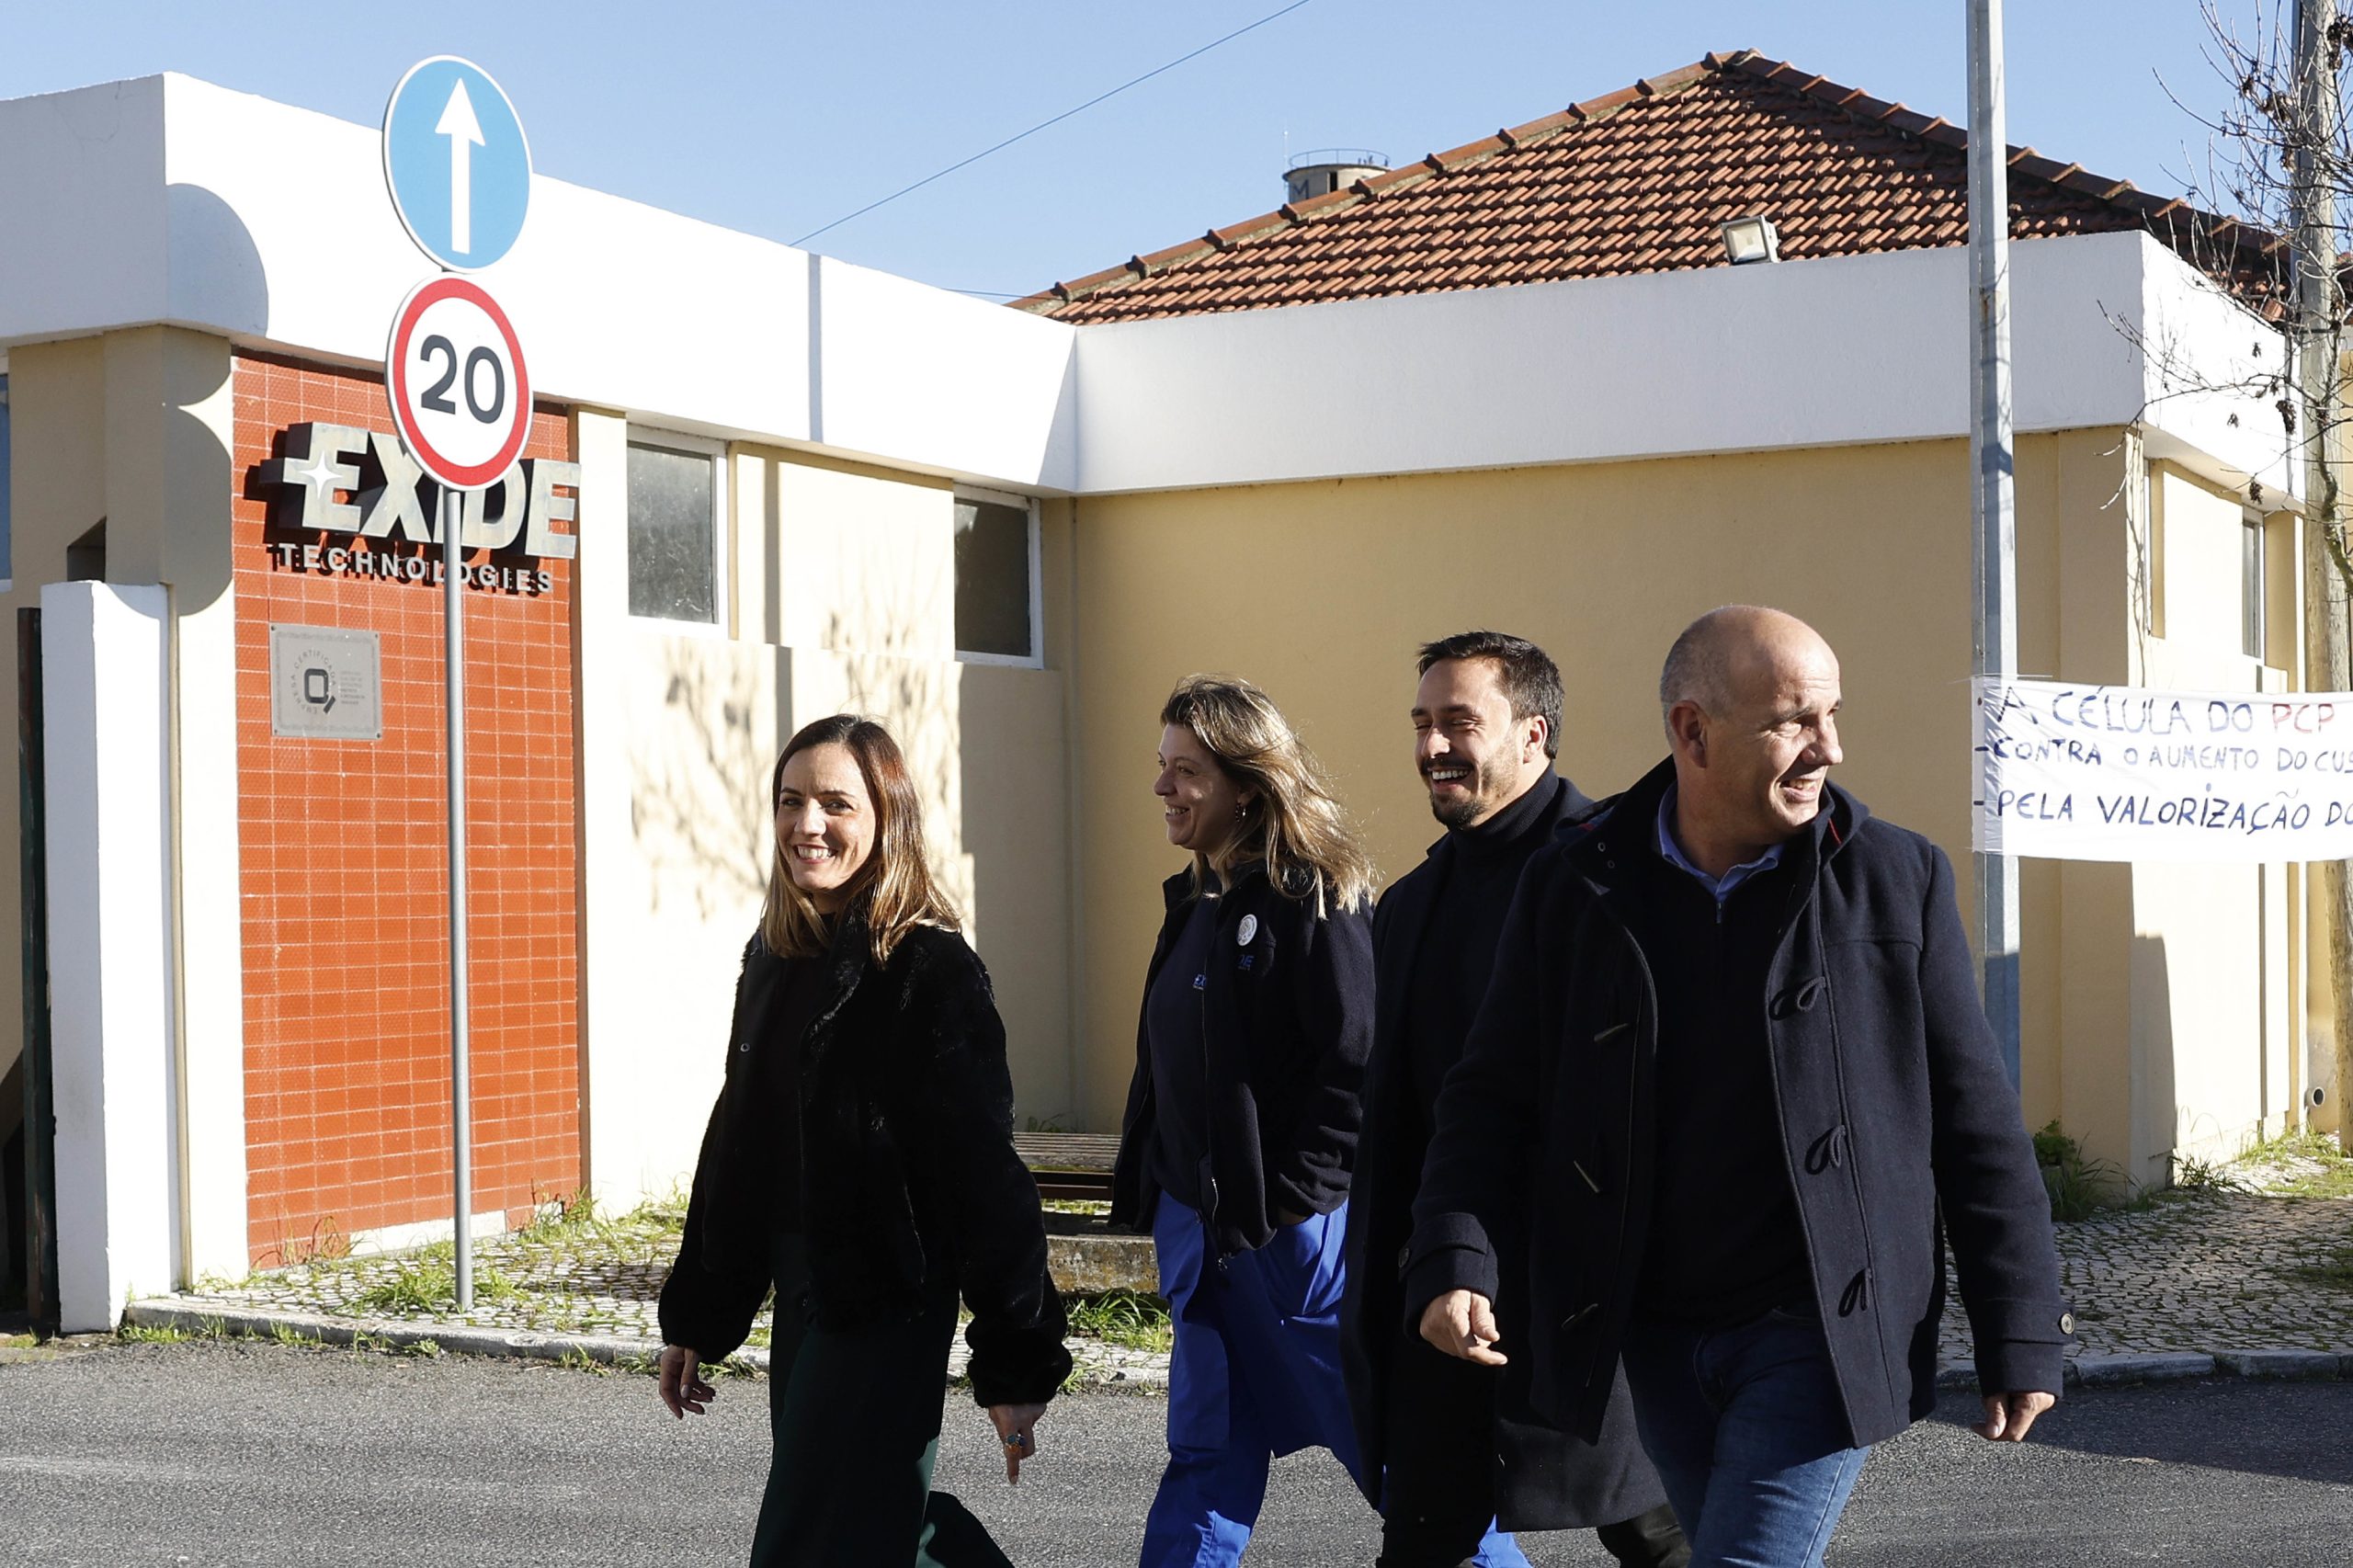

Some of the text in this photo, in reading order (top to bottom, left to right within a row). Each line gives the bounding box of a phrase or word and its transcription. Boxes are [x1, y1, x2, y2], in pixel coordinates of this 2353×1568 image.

[420, 335, 505, 424] 20
[278, 543, 553, 593] TECHNOLOGIES
[1997, 686, 2335, 734] A CÉLULA DO PCP
[2124, 747, 2139, 766] O
[2149, 744, 2258, 771] AUMENTO
[1998, 790, 2073, 822] PELA
[2097, 783, 2311, 835] VALORIZAÇÃO
